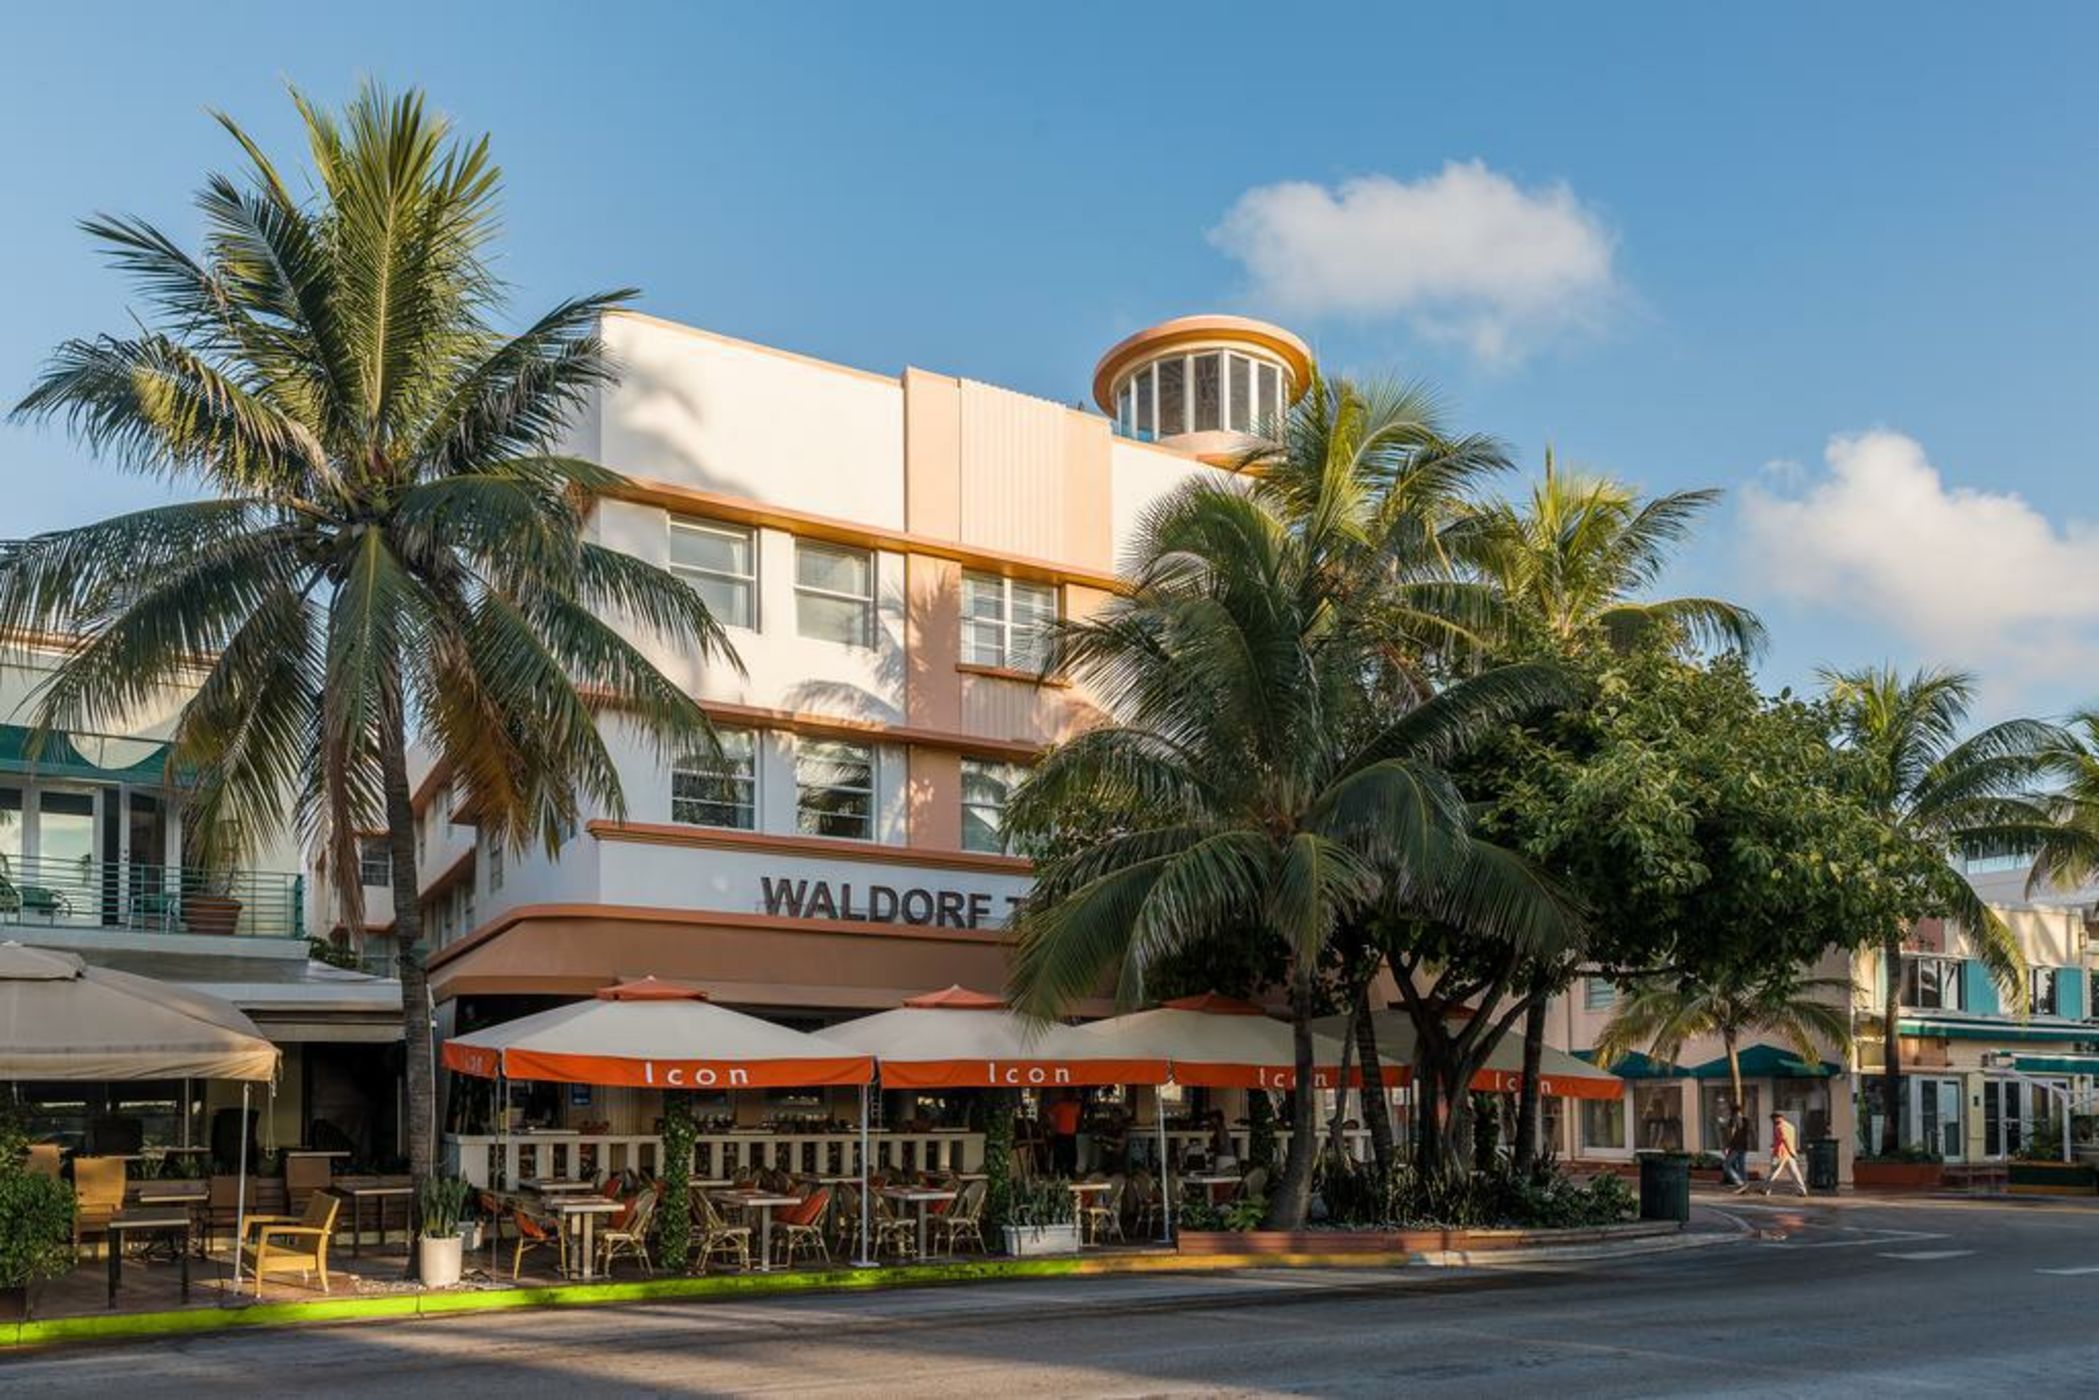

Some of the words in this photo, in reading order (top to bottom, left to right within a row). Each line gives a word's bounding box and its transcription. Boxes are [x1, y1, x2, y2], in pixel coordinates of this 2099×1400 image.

[760, 876, 992, 929] WALDORF
[645, 1061, 749, 1086] Icon
[989, 1062, 1070, 1084] Icon
[1259, 1066, 1329, 1088] Icn
[1495, 1072, 1552, 1094] Icn
